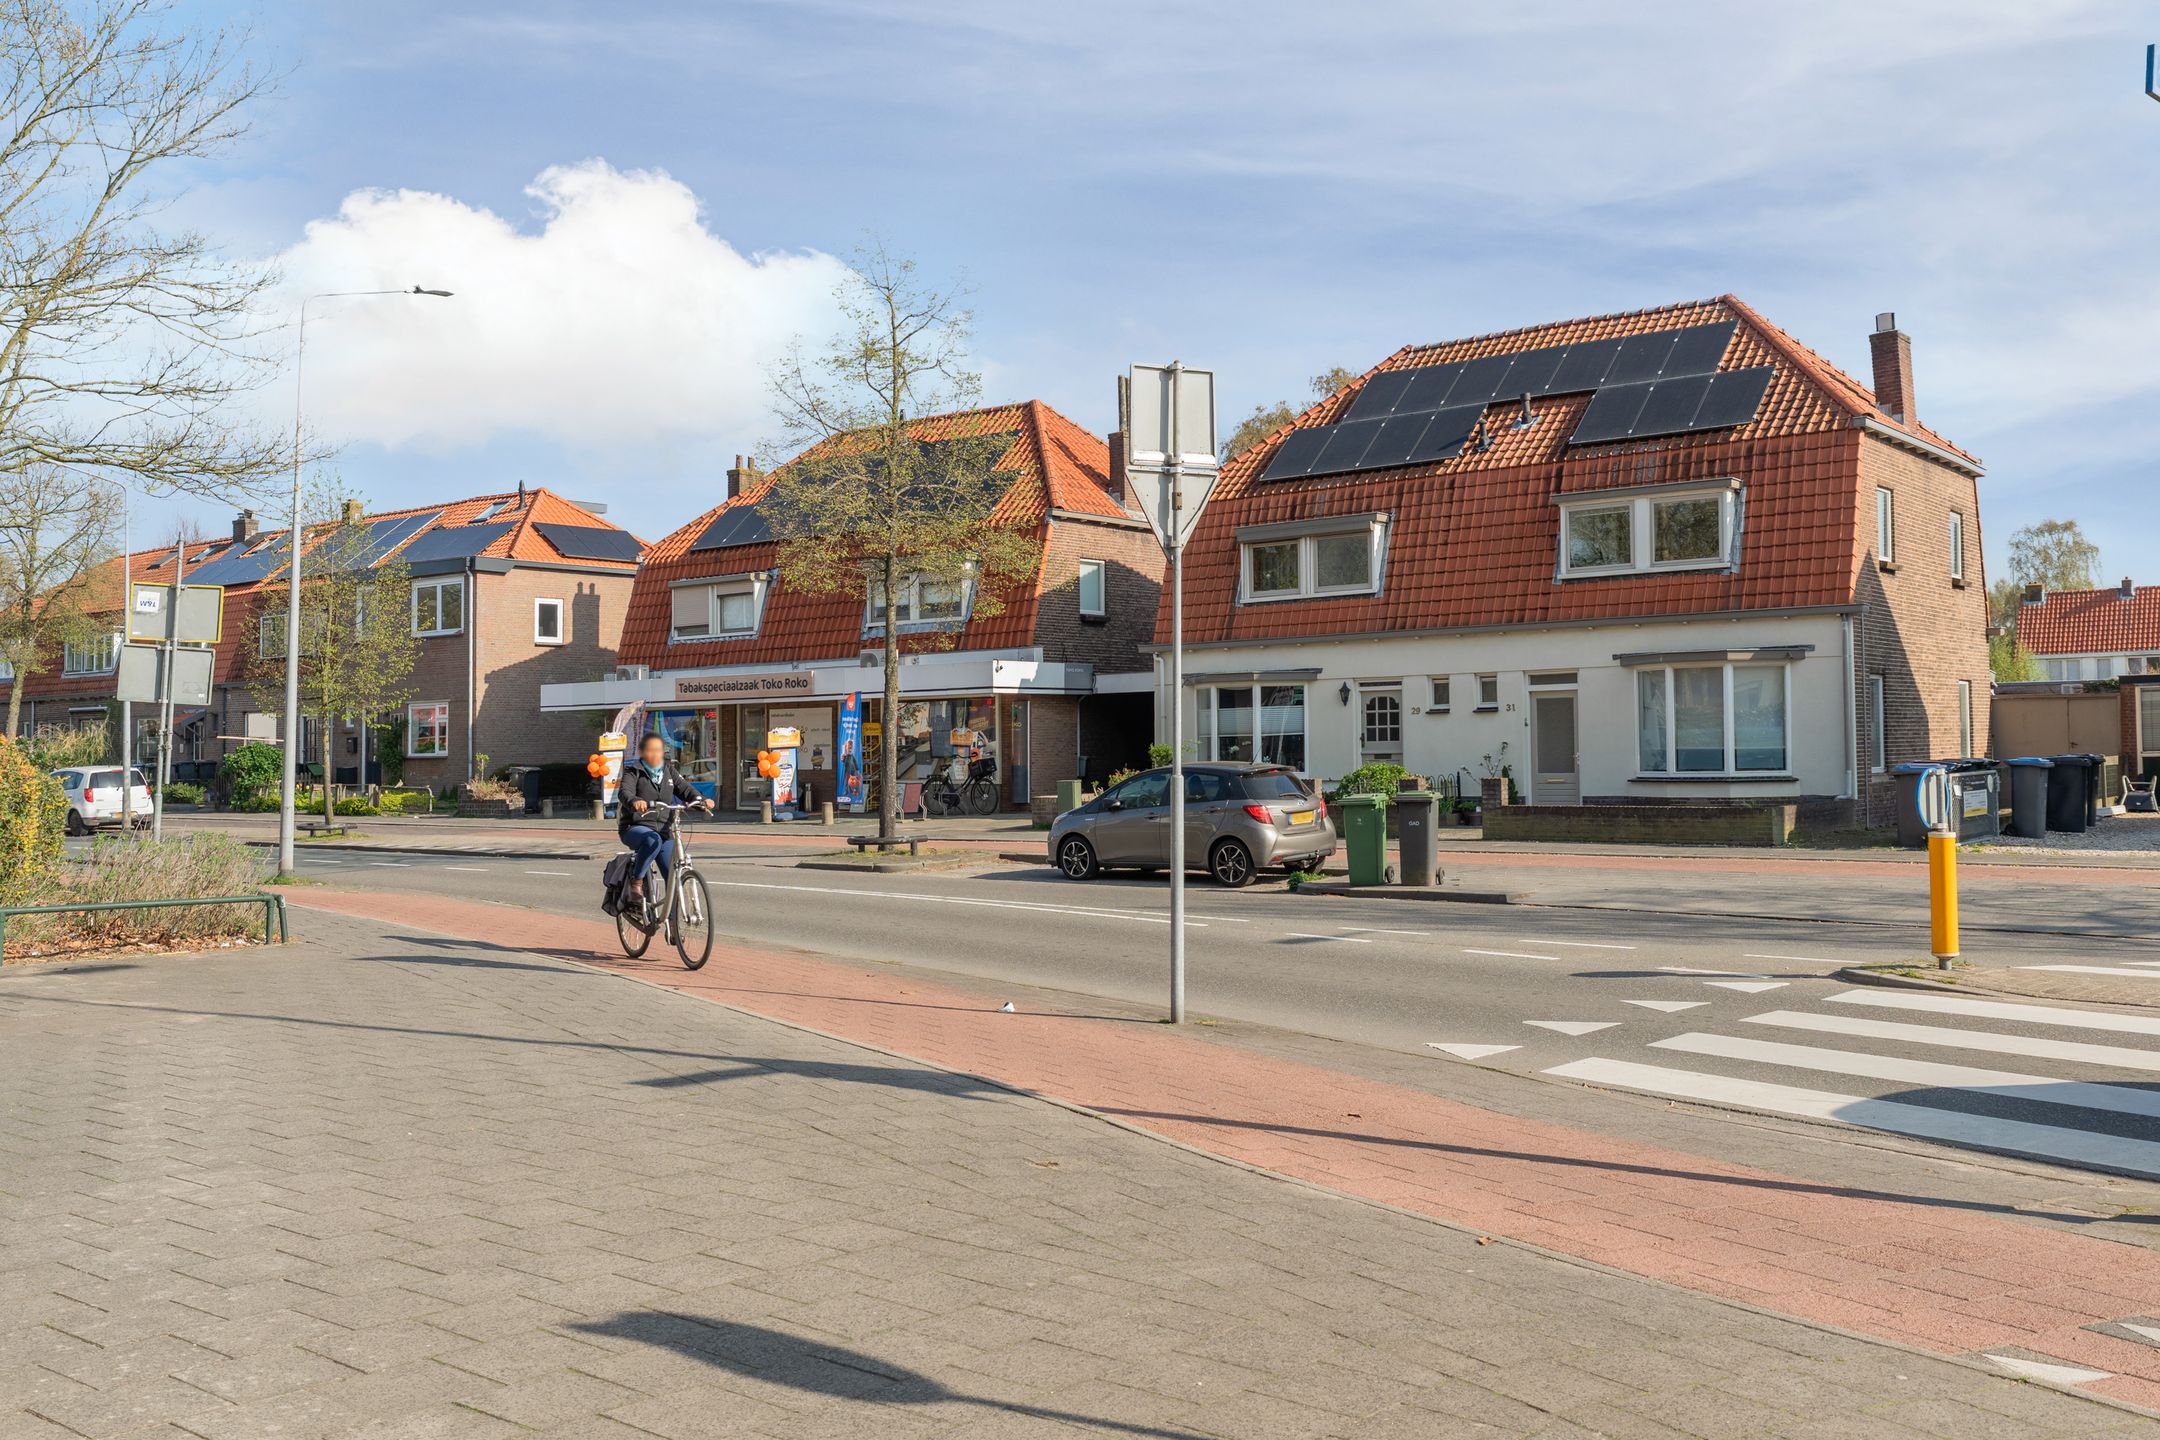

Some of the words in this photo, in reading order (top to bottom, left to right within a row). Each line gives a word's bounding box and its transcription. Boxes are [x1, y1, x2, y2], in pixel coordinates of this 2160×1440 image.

[678, 680, 759, 694] Tabakspeciaalzaak
[760, 678, 783, 690] Toko
[784, 677, 808, 689] Roko
[1411, 706, 1421, 715] 29
[1505, 703, 1516, 712] 31
